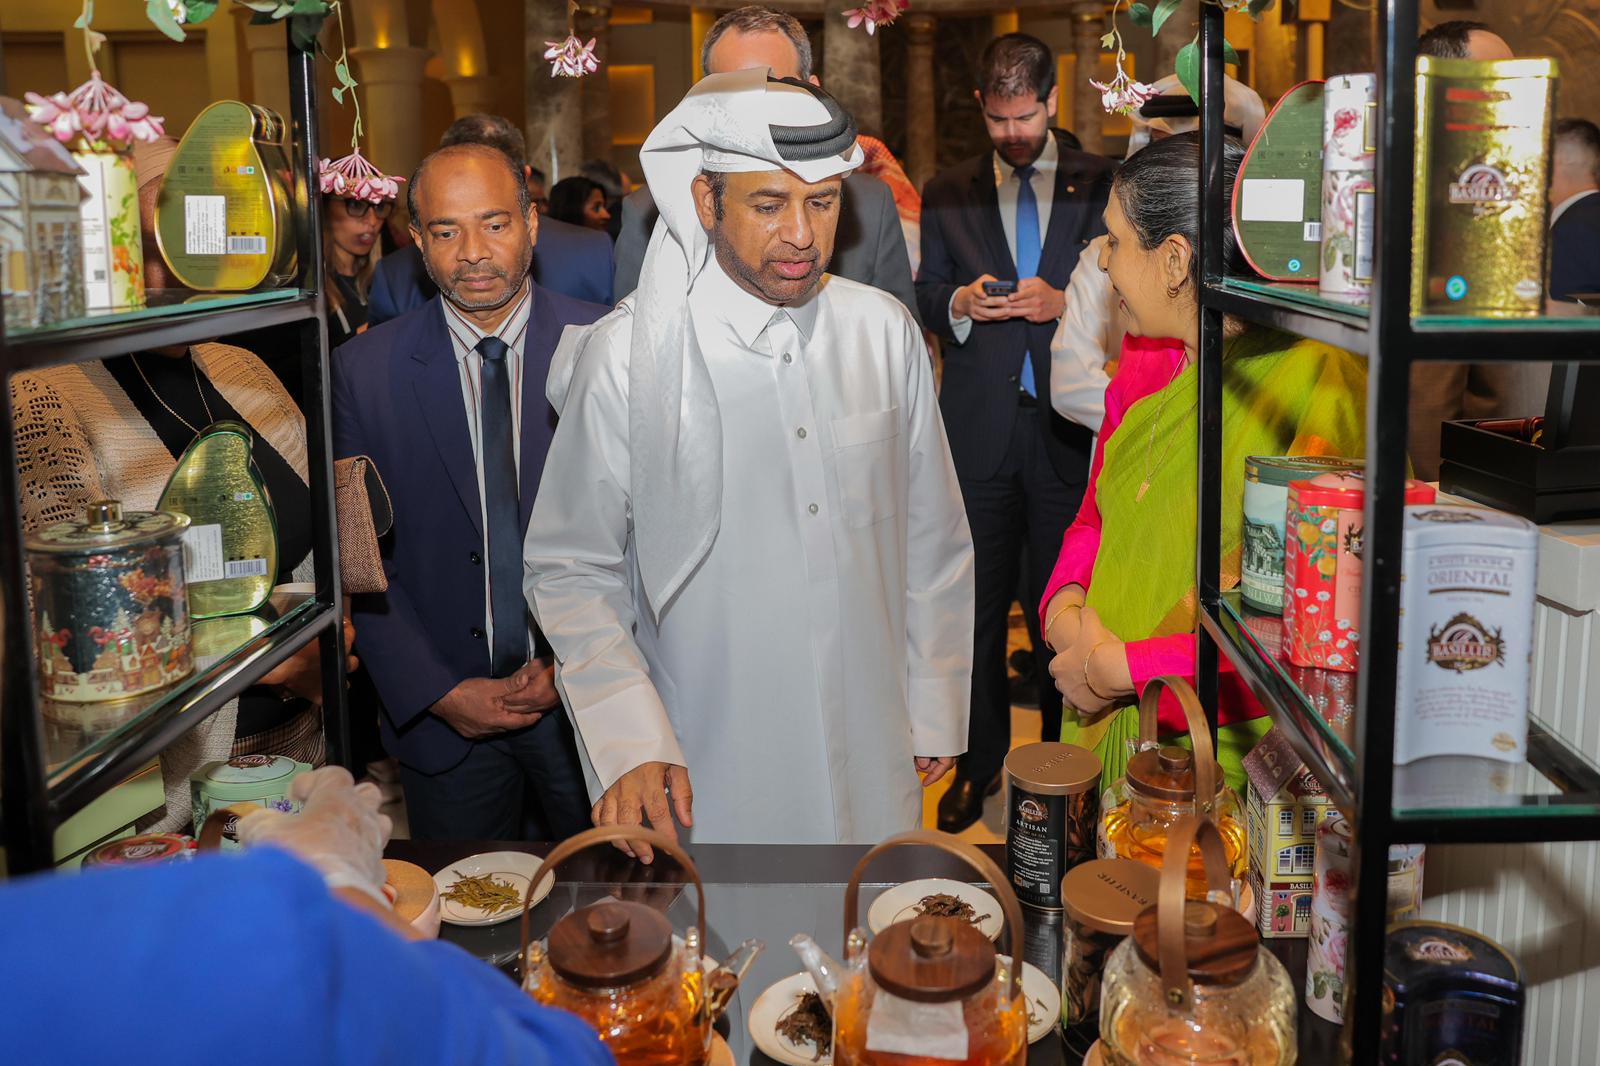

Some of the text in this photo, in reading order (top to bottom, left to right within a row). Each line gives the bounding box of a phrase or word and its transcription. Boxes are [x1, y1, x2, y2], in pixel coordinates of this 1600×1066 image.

[1427, 569, 1512, 588] ORIENTAL
[1432, 643, 1495, 658] BASILUR
[1016, 819, 1048, 833] ARTISAN
